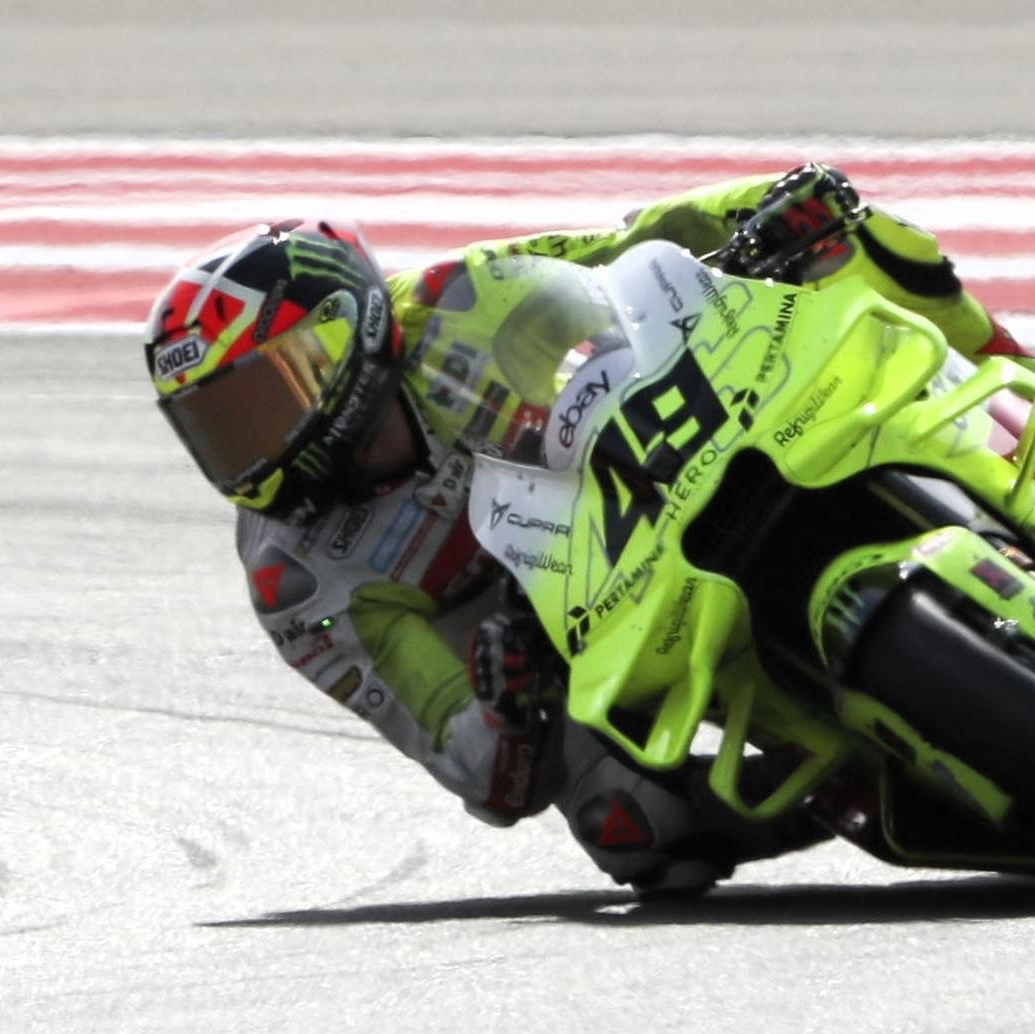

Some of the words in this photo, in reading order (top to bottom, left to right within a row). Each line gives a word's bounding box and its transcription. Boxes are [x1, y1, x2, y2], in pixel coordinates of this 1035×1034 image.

[156, 341, 200, 377] SHOEI
[755, 292, 798, 384] PERTAMINA
[559, 370, 611, 449] ebay
[774, 375, 842, 447] RefugiWear
[590, 345, 730, 567] 49
[667, 449, 717, 521] HERO
[507, 513, 571, 538] CUPRA
[594, 543, 665, 619] PERTAMINA
